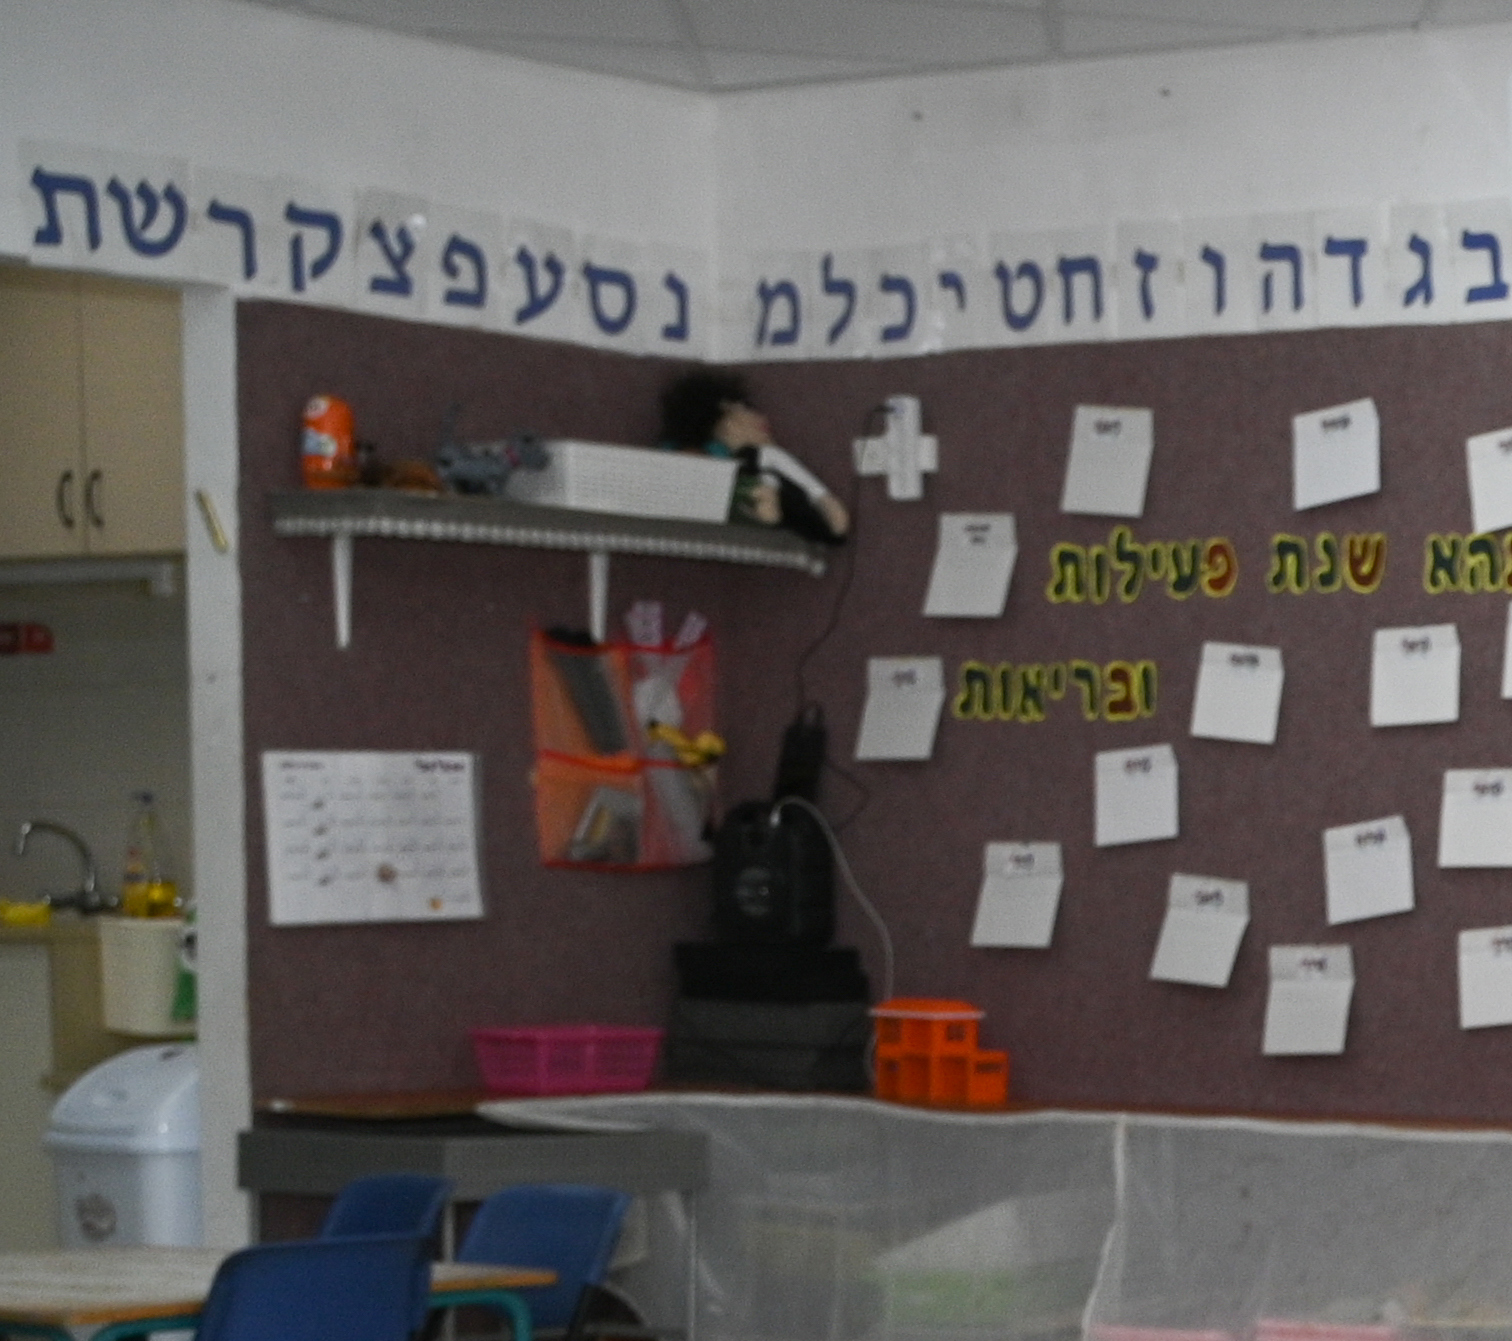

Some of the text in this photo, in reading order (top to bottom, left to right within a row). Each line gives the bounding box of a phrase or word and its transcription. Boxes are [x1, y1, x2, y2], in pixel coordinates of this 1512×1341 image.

[1046, 526, 1238, 603] פעילות
[1269, 531, 1387, 597] שנת
[953, 660, 1158, 723] ובריאות
